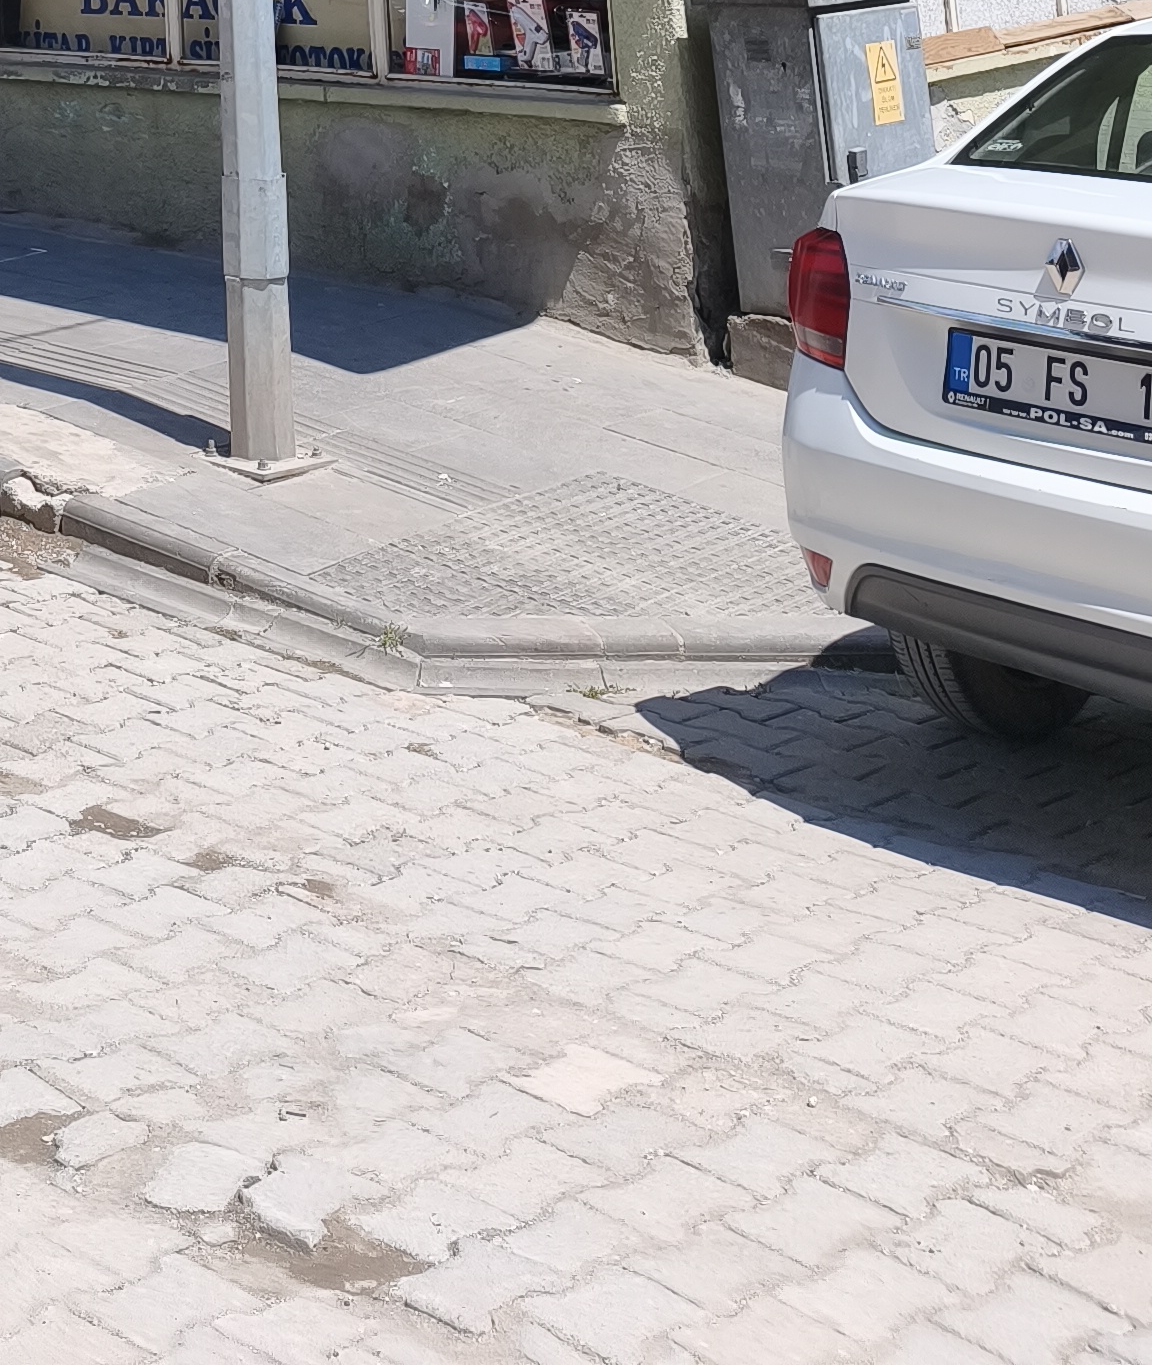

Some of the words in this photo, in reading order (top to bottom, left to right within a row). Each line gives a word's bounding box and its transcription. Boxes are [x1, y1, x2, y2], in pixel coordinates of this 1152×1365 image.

[997, 297, 1136, 334] SYMBOL
[954, 367, 968, 382] TR
[973, 344, 1014, 393] 05
[1045, 355, 1089, 407] FS
[956, 393, 985, 405] RENAULT
[1003, 407, 1134, 439] www.POL-SA.com
